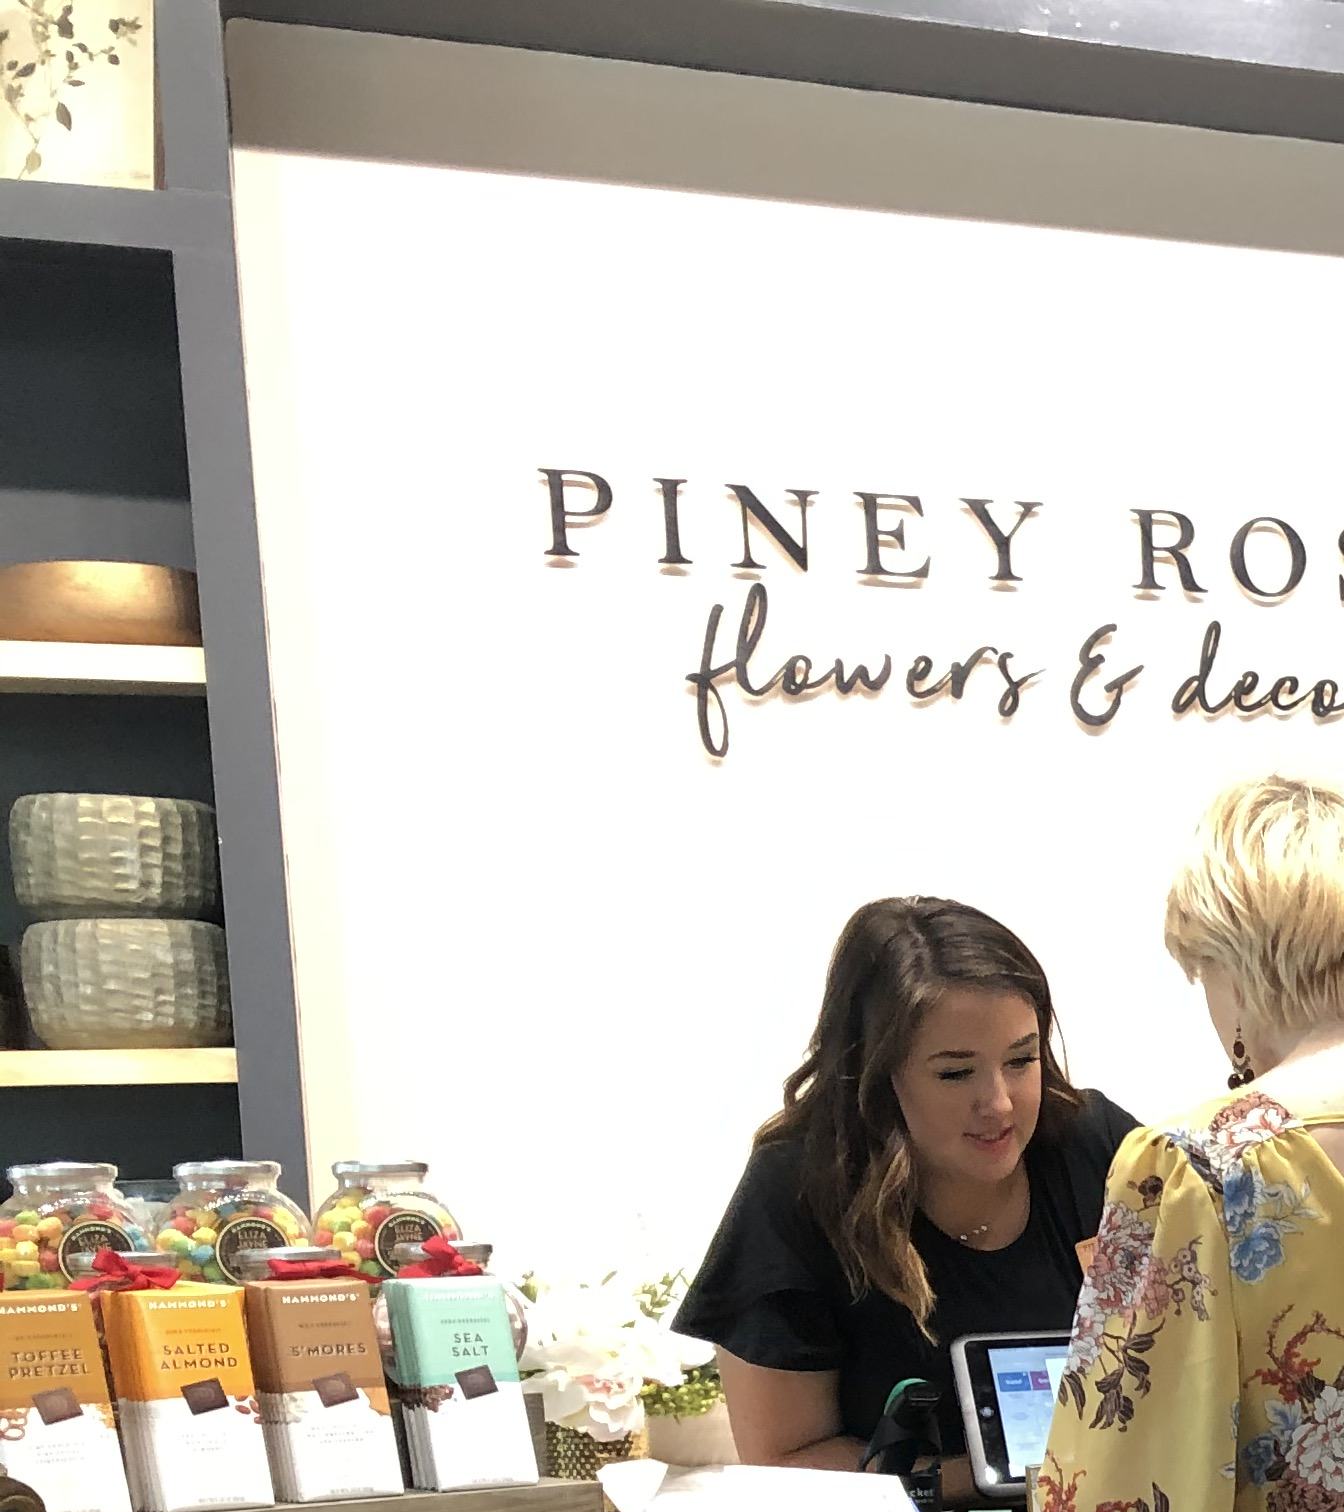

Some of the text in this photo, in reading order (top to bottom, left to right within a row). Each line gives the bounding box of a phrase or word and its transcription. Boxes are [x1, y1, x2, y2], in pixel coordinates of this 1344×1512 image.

[538, 468, 1043, 583] PINEY
[687, 582, 1040, 757] flowers
[1070, 623, 1143, 727] &
[148, 1299, 228, 1310] HAMMOND'S
[282, 1293, 357, 1304] HAMMOND'S
[453, 1332, 484, 1344] SEA
[11, 1349, 83, 1362] TOFFEE
[163, 1343, 230, 1356] SALTED
[289, 1342, 367, 1357] S'MORES
[451, 1345, 489, 1357] SALT
[161, 1357, 238, 1370] ALMOND
[9, 1363, 91, 1378] PRETZEL
